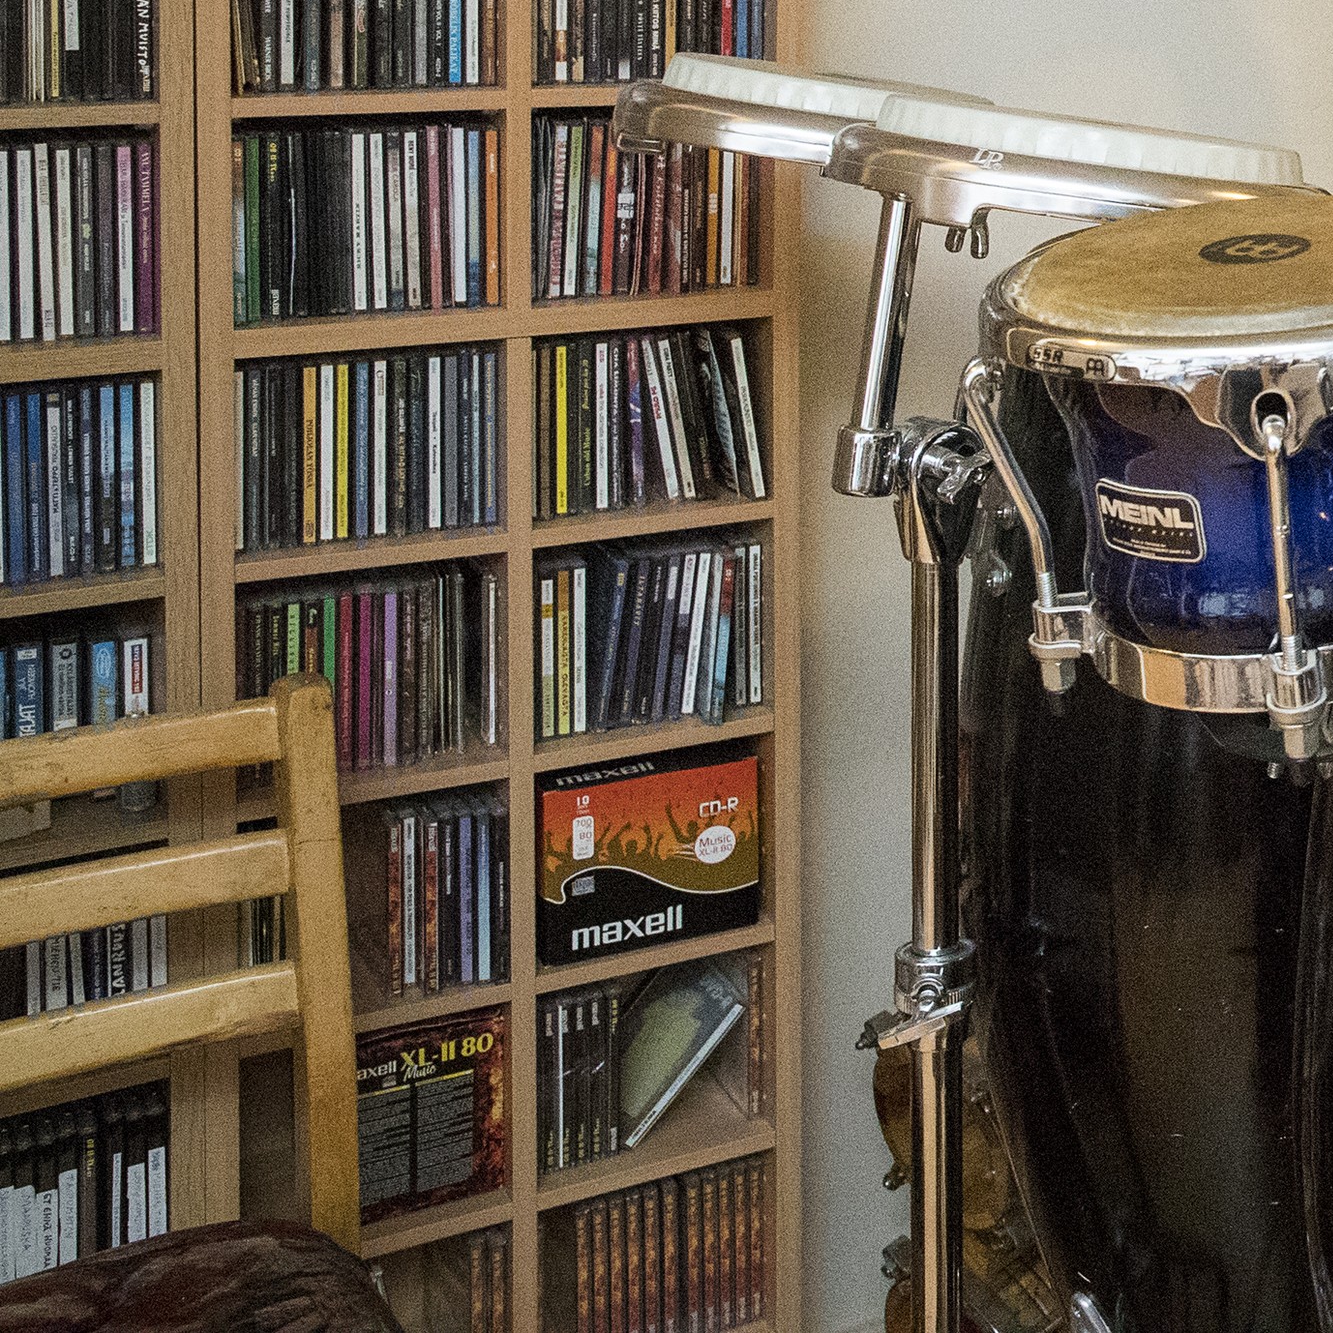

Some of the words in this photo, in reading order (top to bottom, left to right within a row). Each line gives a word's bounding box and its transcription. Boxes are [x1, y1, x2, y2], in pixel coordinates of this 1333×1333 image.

[1099, 494, 1195, 530] MEINL
[556, 761, 657, 787] maxell
[698, 796, 740, 819] CD-R
[698, 832, 734, 852] Music
[570, 904, 684, 952] maxell
[357, 1059, 398, 1082] axell
[401, 1039, 457, 1073] XL-II
[460, 1032, 495, 1058] 80
